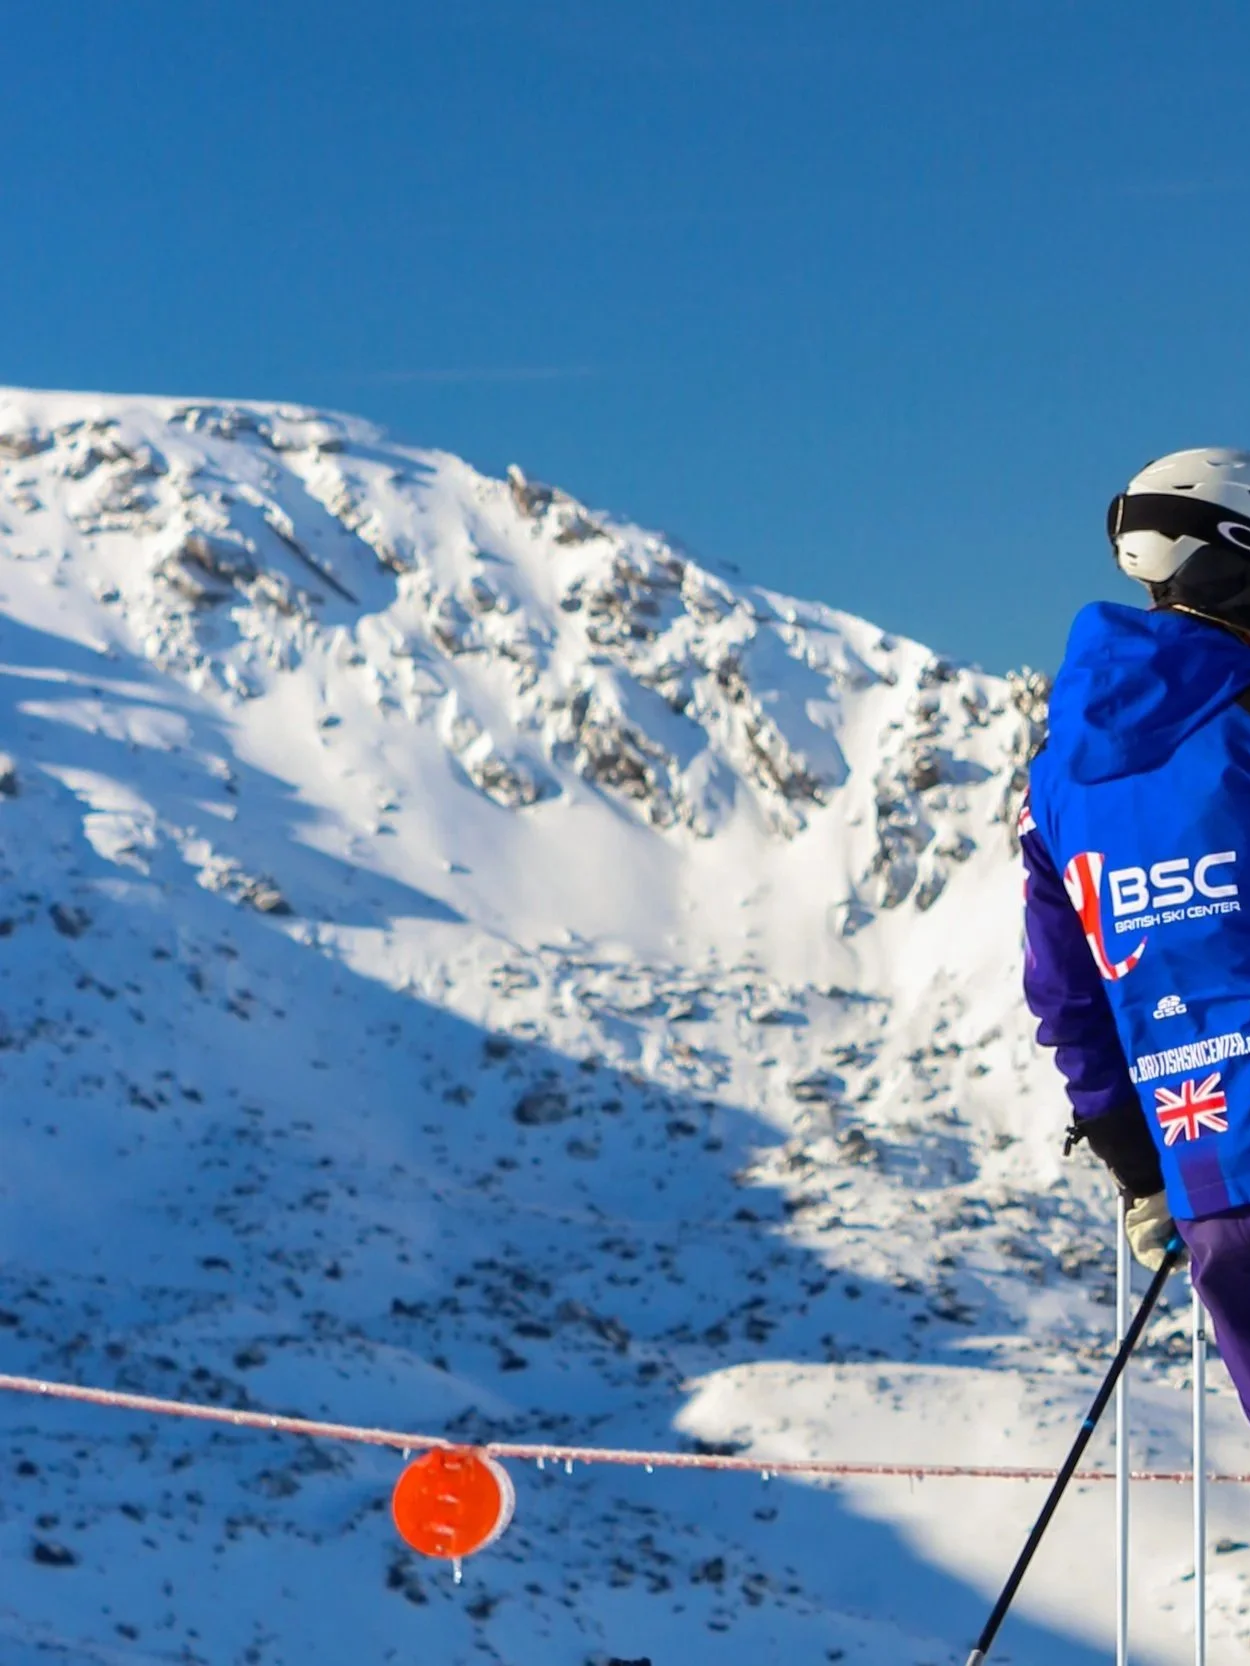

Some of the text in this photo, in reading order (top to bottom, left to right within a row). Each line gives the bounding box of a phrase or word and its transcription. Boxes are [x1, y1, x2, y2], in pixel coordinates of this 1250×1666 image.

[1108, 850, 1238, 917] BSC
[1114, 900, 1241, 934] BRITISH SKI CENTER
